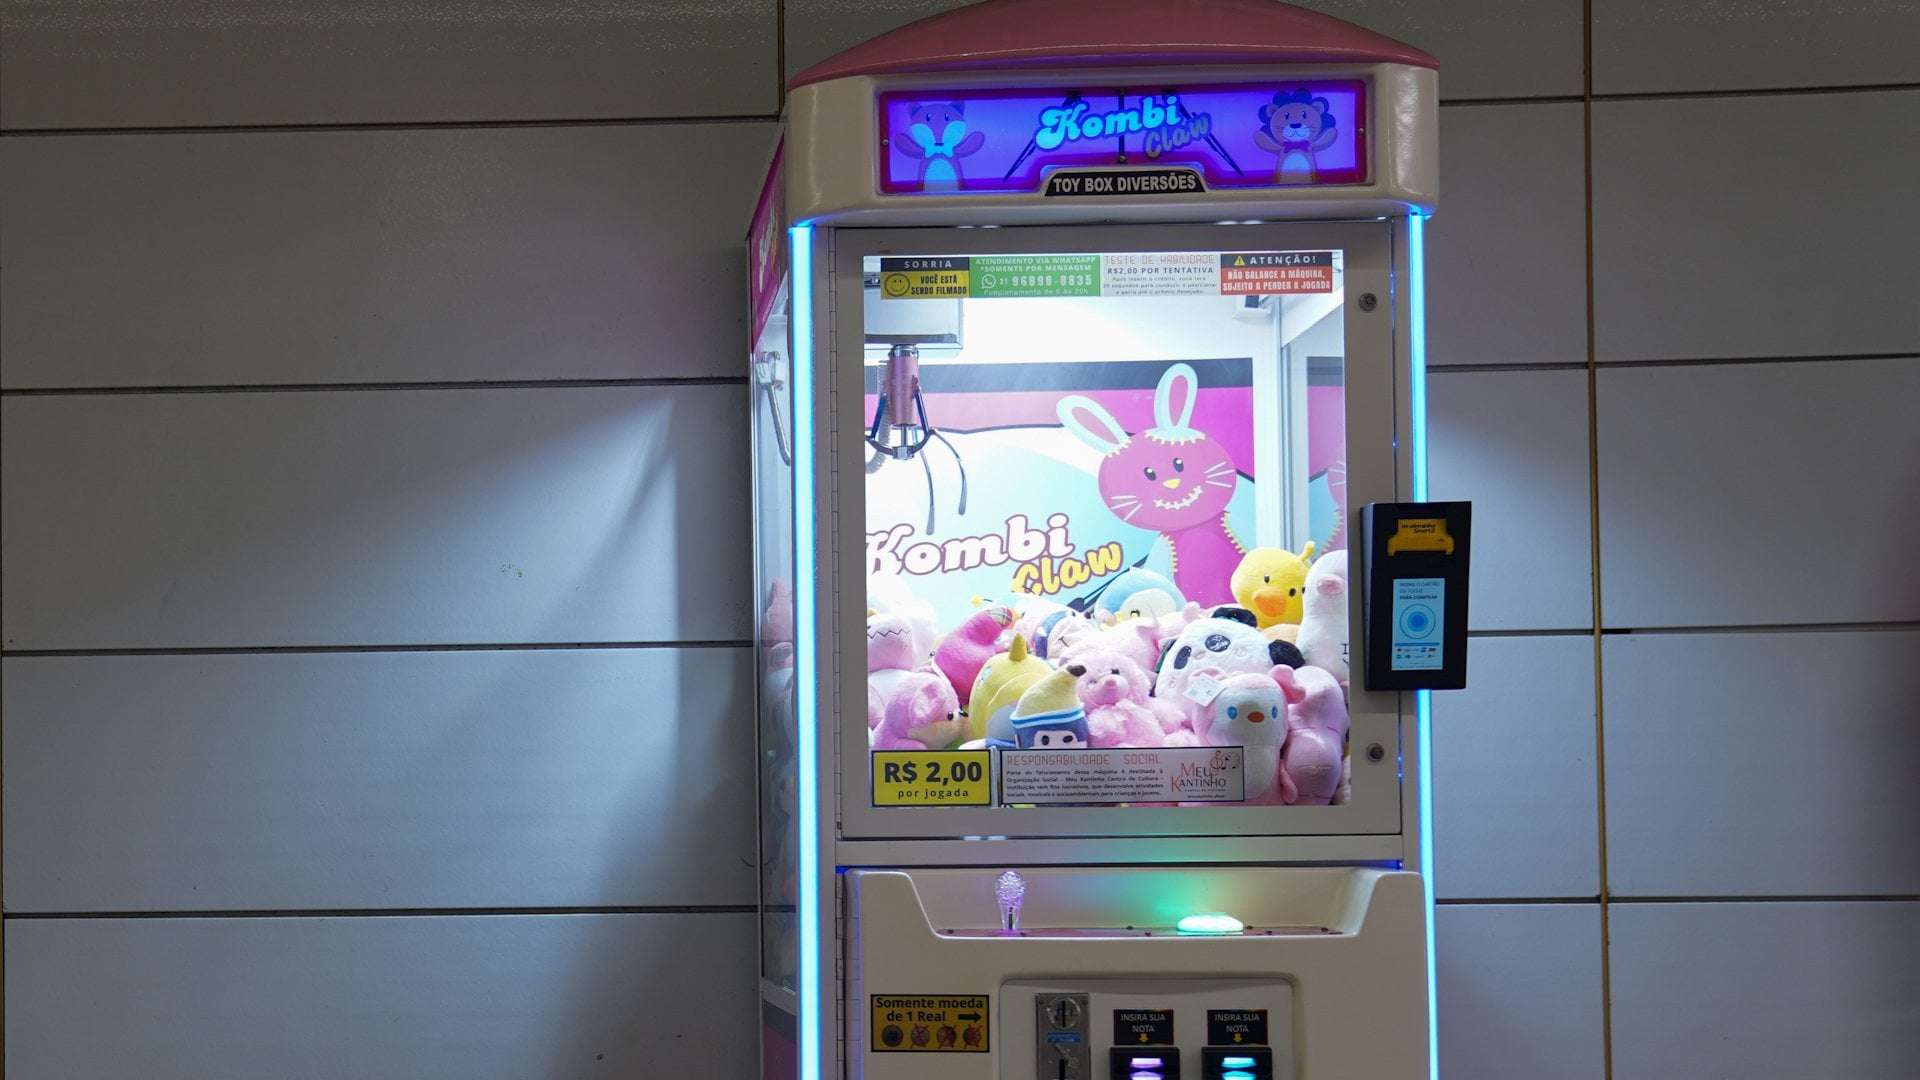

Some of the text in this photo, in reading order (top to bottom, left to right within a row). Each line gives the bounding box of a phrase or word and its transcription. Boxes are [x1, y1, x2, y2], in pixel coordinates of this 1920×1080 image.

[1034, 94, 1183, 151] Kombi
[1144, 112, 1211, 158] Claw
[1053, 172, 1197, 193] TOY BOX DIVERSÕES
[904, 260, 953, 269] SORRIA
[976, 257, 1034, 265] ATENDIMENTO
[1036, 256, 1050, 264] VIA
[1249, 254, 1317, 266] ATENÇÃO!
[920, 273, 957, 284] VOCÊ ESTÁ
[1227, 269, 1243, 280] NÃO
[1245, 270, 1278, 279] BALANCE
[1281, 270, 1286, 279] A
[911, 286, 967, 295] SENDO FILMADO
[1222, 280, 1331, 291] SUJEITO A PERDER A JOGADA
[866, 512, 1076, 576] Kombi
[1011, 541, 1123, 596] Claw
[1007, 752, 1162, 766] RESPONSABILIDADE SOCIAL
[884, 761, 982, 786] R$ 2,00
[898, 788, 969, 799] por jogada
[875, 997, 983, 1009] Somente moeda
[886, 1010, 946, 1022] de 1 Real
[1121, 1013, 1166, 1022] INSIRA SUA
[1214, 1013, 1260, 1022] INSIRA SUA
[1132, 1024, 1155, 1033] NOTA
[1226, 1024, 1249, 1033] NOTA
